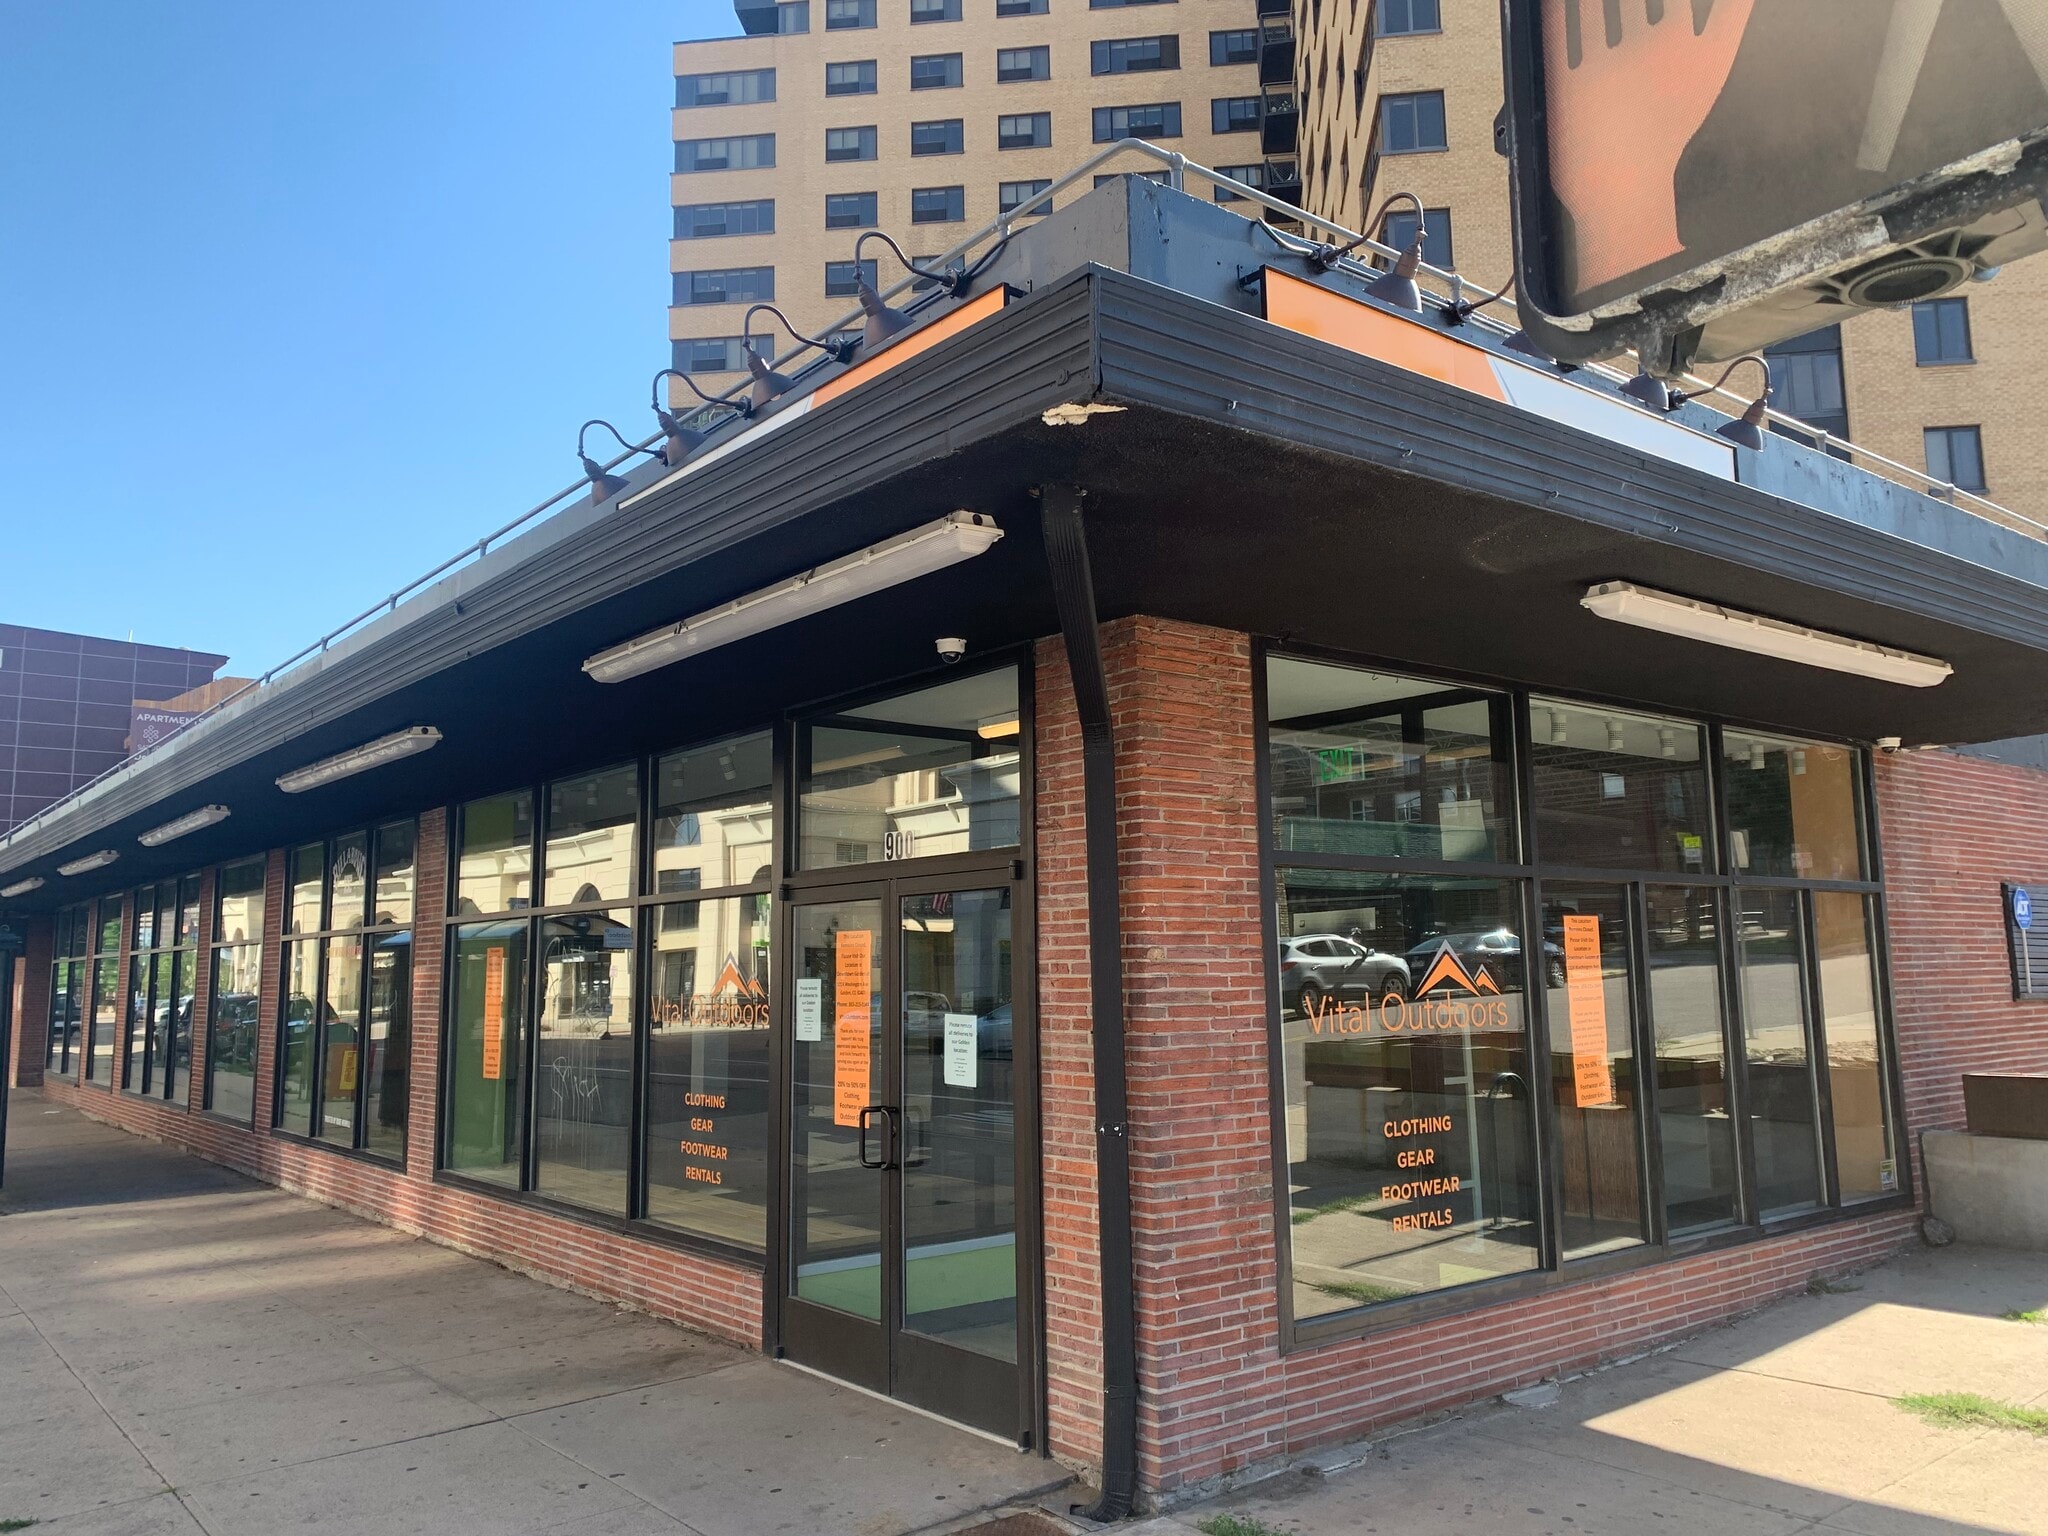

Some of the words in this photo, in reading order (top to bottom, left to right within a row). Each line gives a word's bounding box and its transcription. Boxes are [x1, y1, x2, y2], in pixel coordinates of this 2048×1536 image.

[1318, 747, 1353, 781] EXIT
[886, 830, 914, 860] 900
[651, 993, 683, 1024] Vital
[688, 993, 770, 1026] Outdoors
[1305, 991, 1371, 1034] Vital
[1381, 990, 1509, 1032] Outdoors
[685, 1092, 725, 1109] CLOTHING
[691, 1117, 713, 1132] GEAR
[1384, 1115, 1452, 1138] CLOTHING
[681, 1141, 728, 1160] FOOTWEAR
[1397, 1149, 1434, 1168] GEAR
[685, 1166, 721, 1185] RENTALS
[1382, 1176, 1460, 1203] FOOTWEAR
[1393, 1208, 1453, 1233] RENTALS
